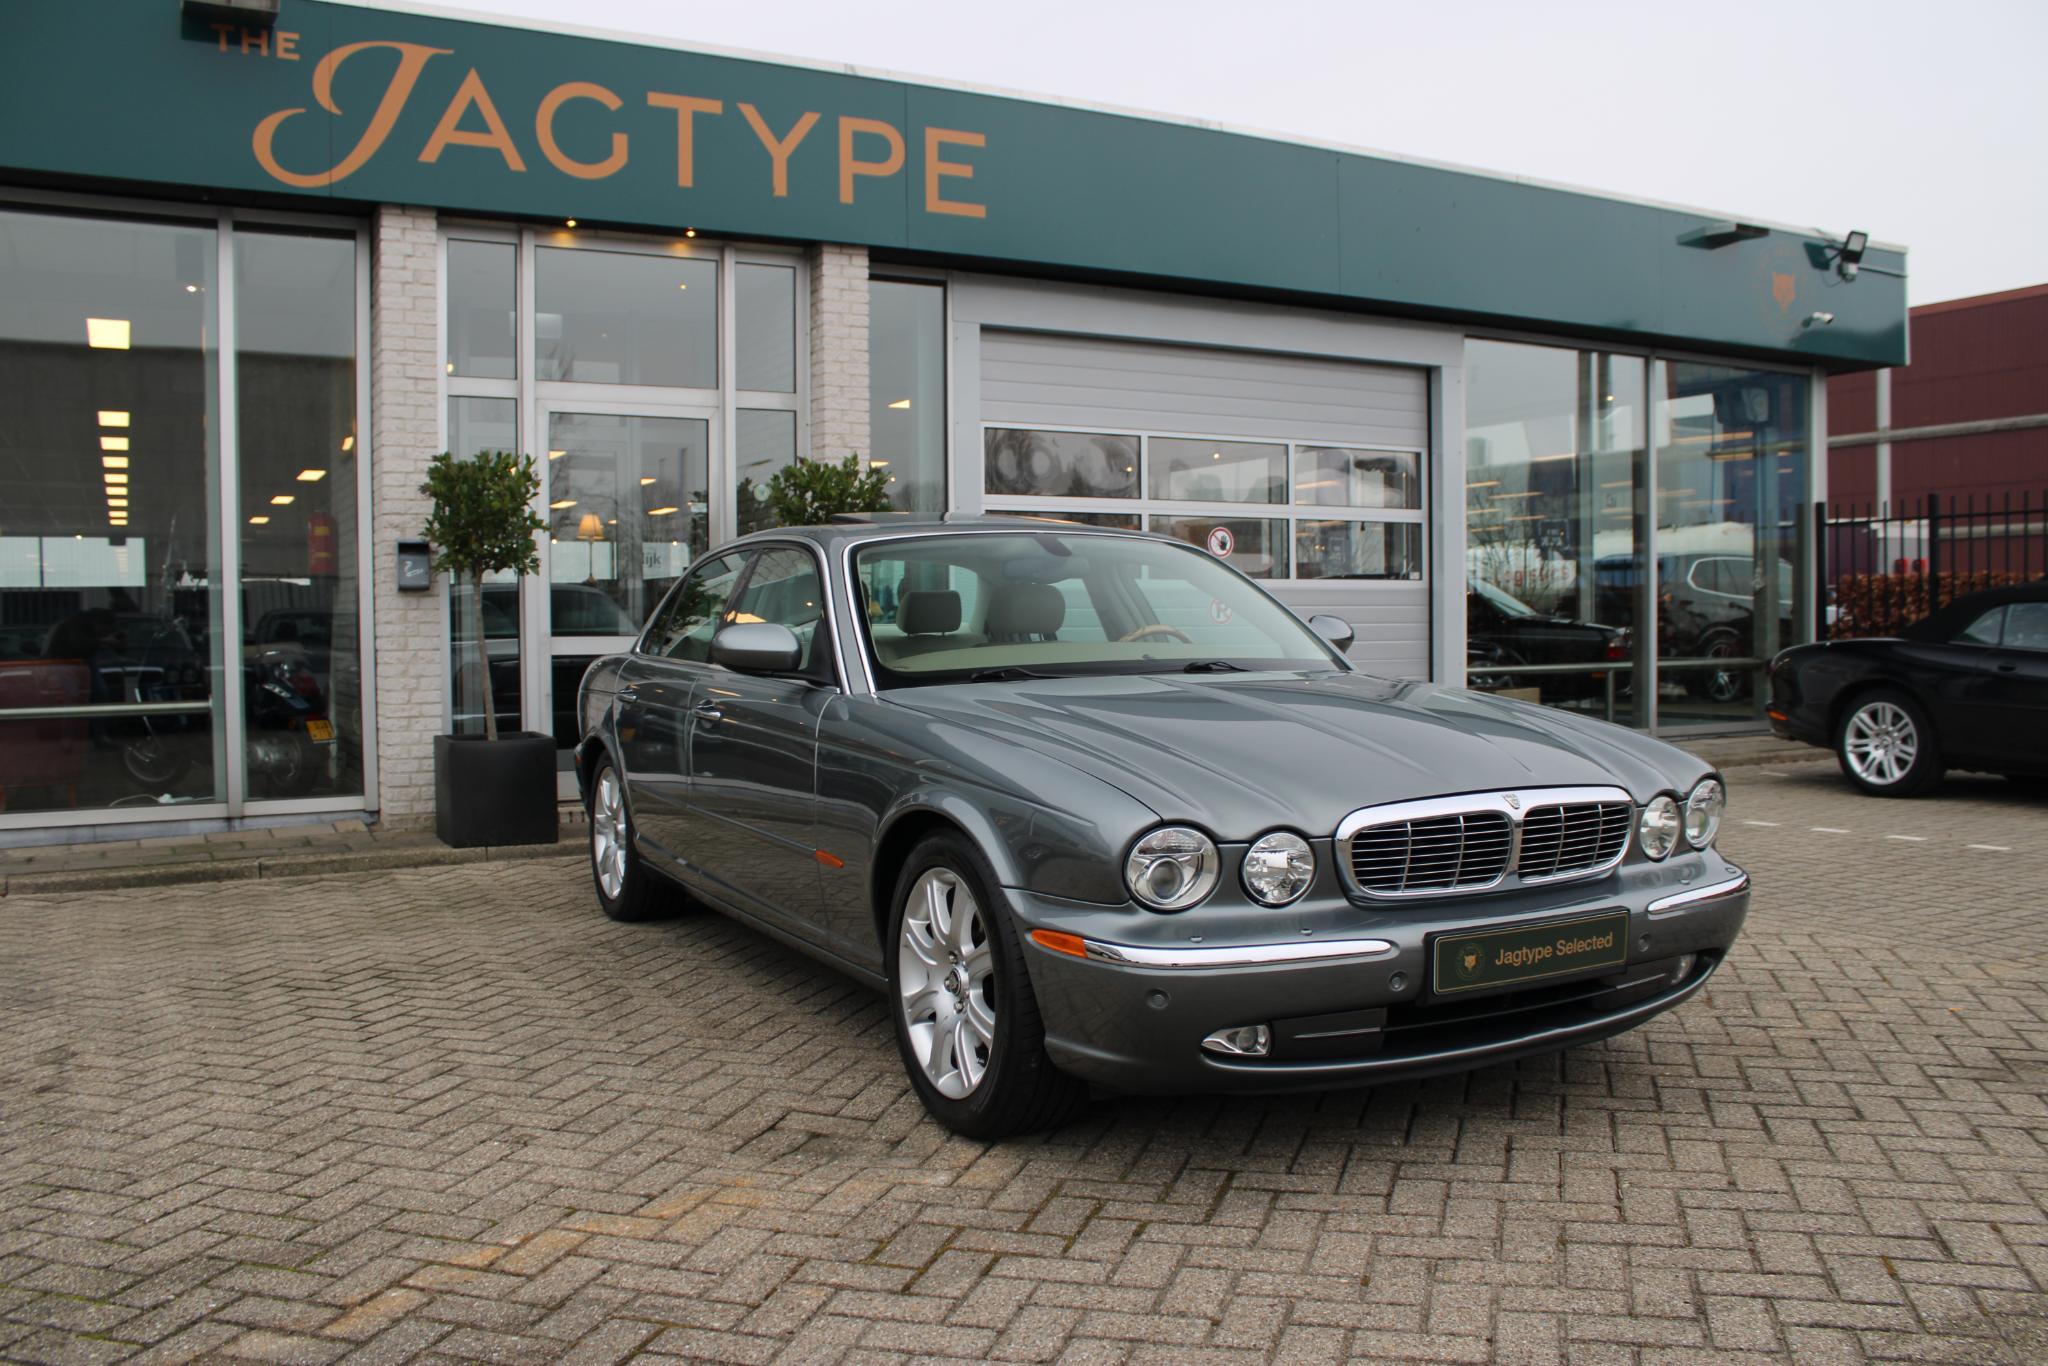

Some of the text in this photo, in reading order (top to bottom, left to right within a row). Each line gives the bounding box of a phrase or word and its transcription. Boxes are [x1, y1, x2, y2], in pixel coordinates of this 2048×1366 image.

[210, 23, 300, 61] THE
[252, 40, 987, 219] JAGTYPE
[1495, 946, 1553, 967] Jagtype
[1556, 931, 1614, 956] Selected
